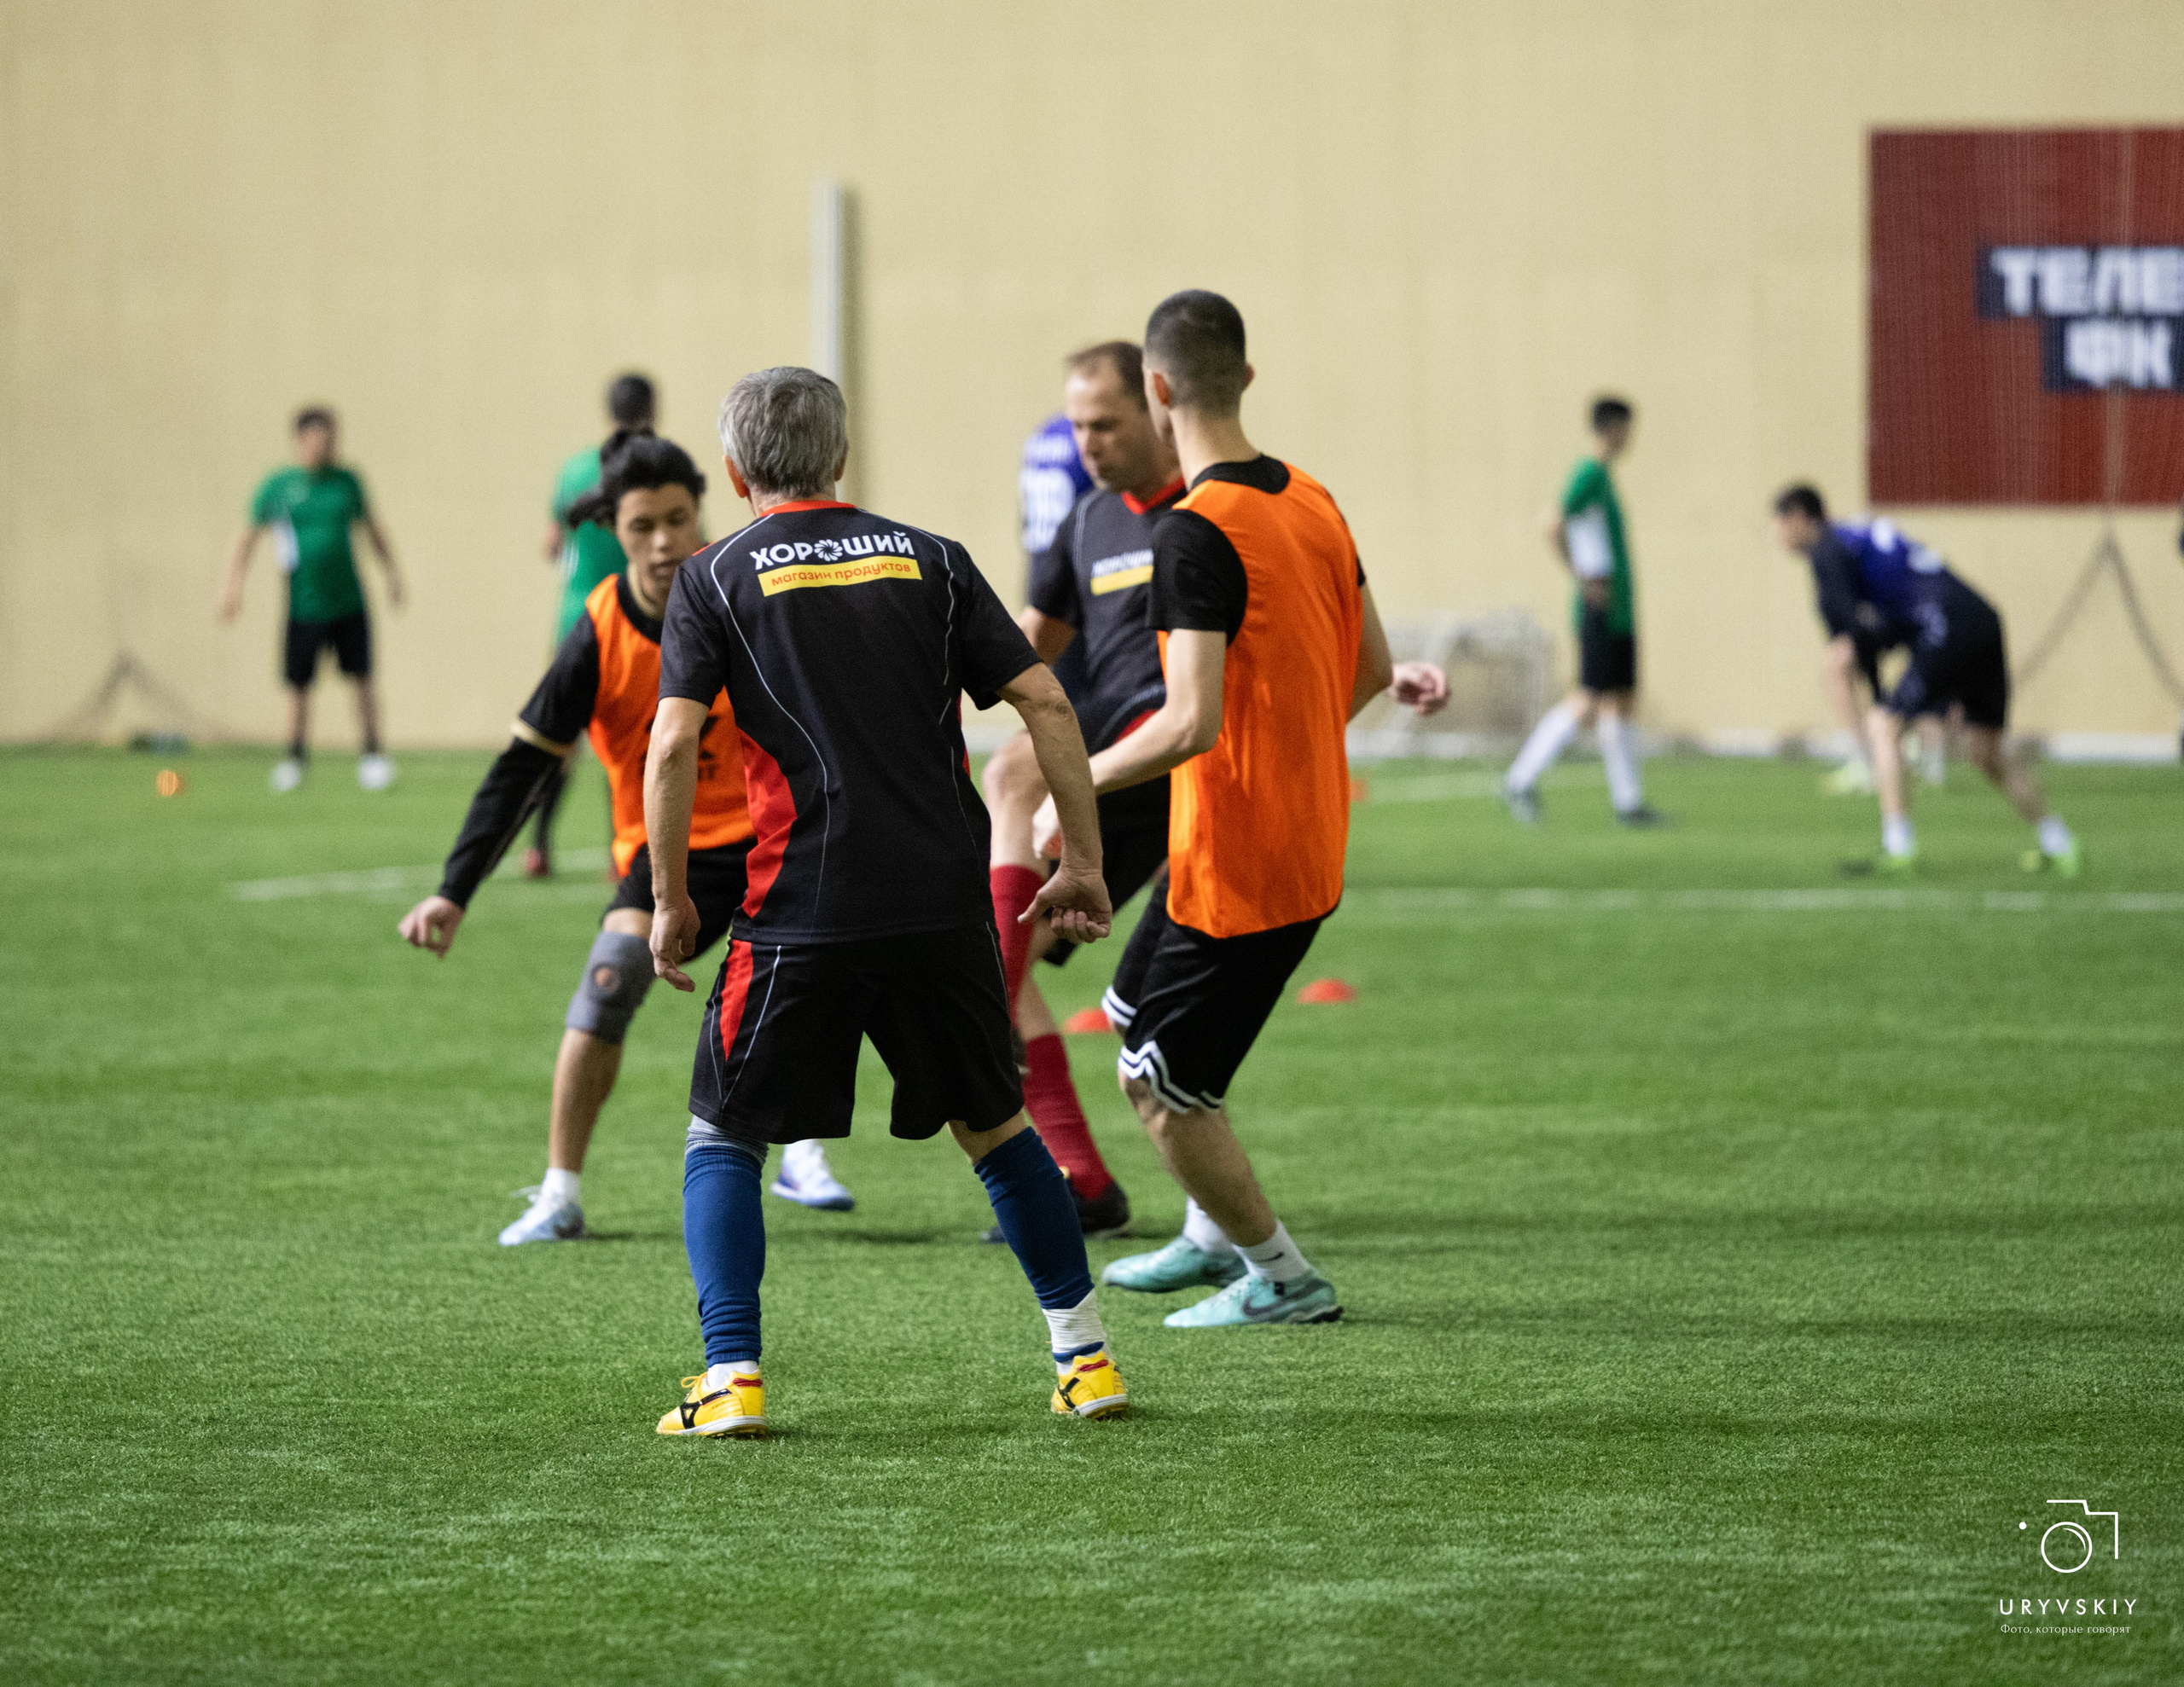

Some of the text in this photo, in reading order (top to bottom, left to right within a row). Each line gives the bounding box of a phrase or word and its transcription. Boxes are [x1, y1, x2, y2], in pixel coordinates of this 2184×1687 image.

[749, 530, 915, 571] ХОРОШИЙ
[771, 562, 911, 586] магазин продуктов
